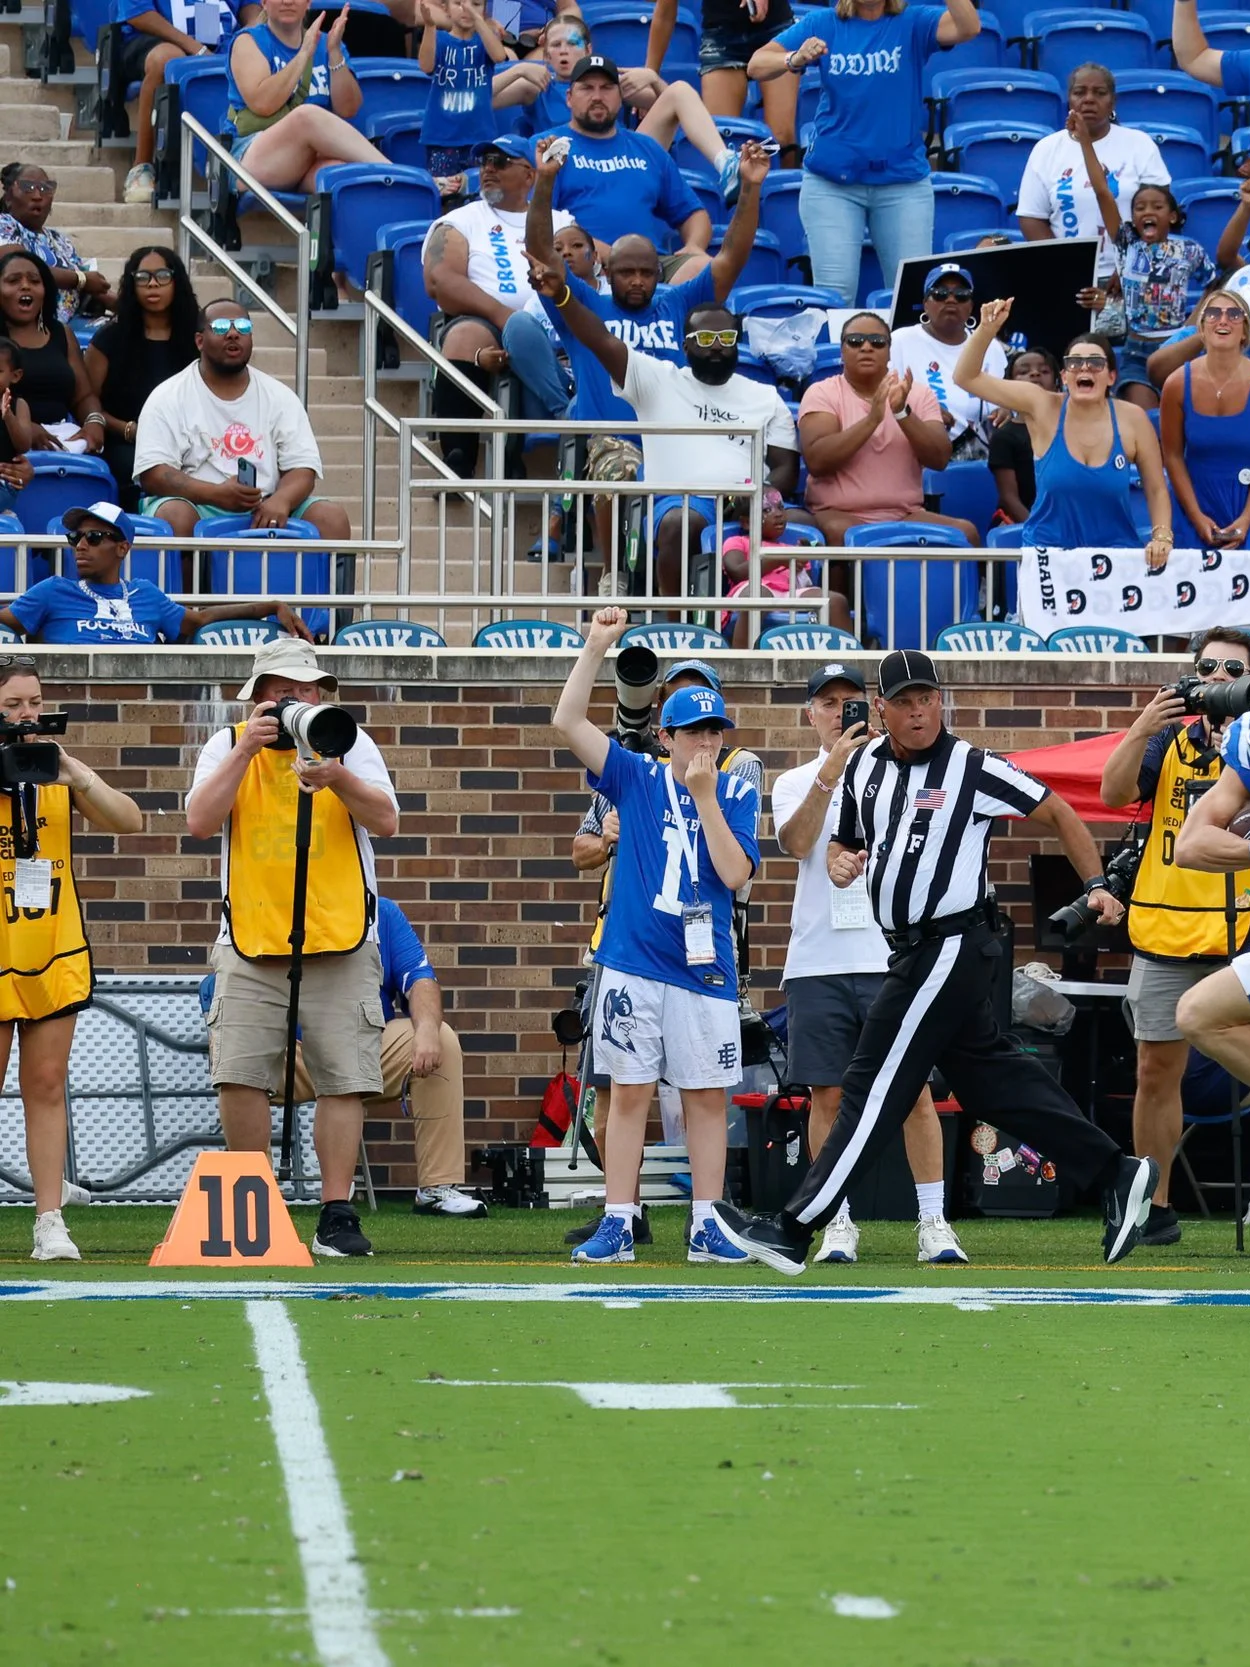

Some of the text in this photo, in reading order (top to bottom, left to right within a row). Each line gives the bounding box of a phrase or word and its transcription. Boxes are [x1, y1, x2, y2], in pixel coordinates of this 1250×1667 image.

[463, 45, 478, 65] IT
[590, 56, 604, 67] D
[466, 65, 488, 88] THE
[443, 91, 475, 113] WIN
[490, 231, 518, 294] BROWN
[605, 319, 680, 351] DUKE
[691, 690, 716, 703] DUKE
[699, 700, 713, 713] D
[680, 794, 692, 806] D
[907, 833, 925, 854] F
[199, 1175, 271, 1257] 10
